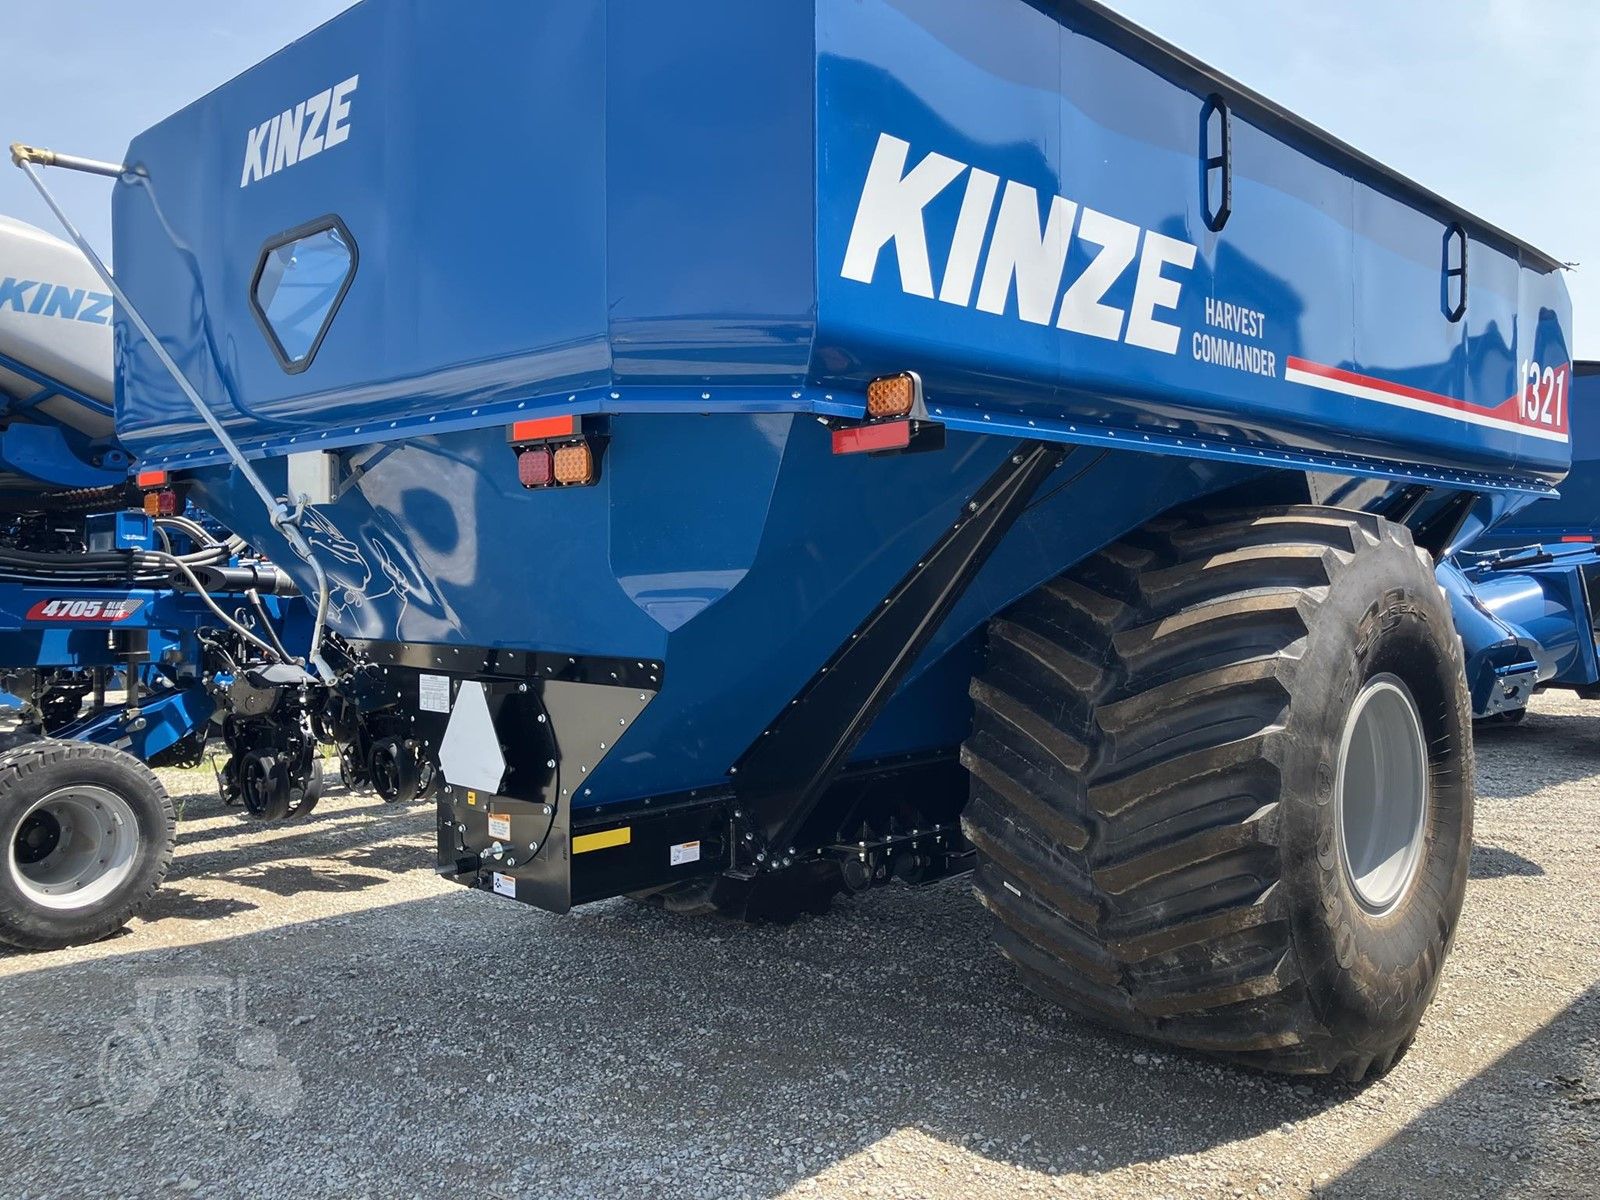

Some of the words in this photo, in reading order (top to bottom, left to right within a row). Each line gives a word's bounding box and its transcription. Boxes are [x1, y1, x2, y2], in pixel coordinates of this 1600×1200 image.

[240, 74, 359, 188] KINZE
[840, 132, 1198, 355] KINZE
[0, 277, 113, 325] KINZ
[1205, 296, 1265, 339] HARVEST
[1192, 331, 1277, 378] COMMANDER
[1521, 359, 1565, 427] 1321
[41, 600, 103, 618] 4705
